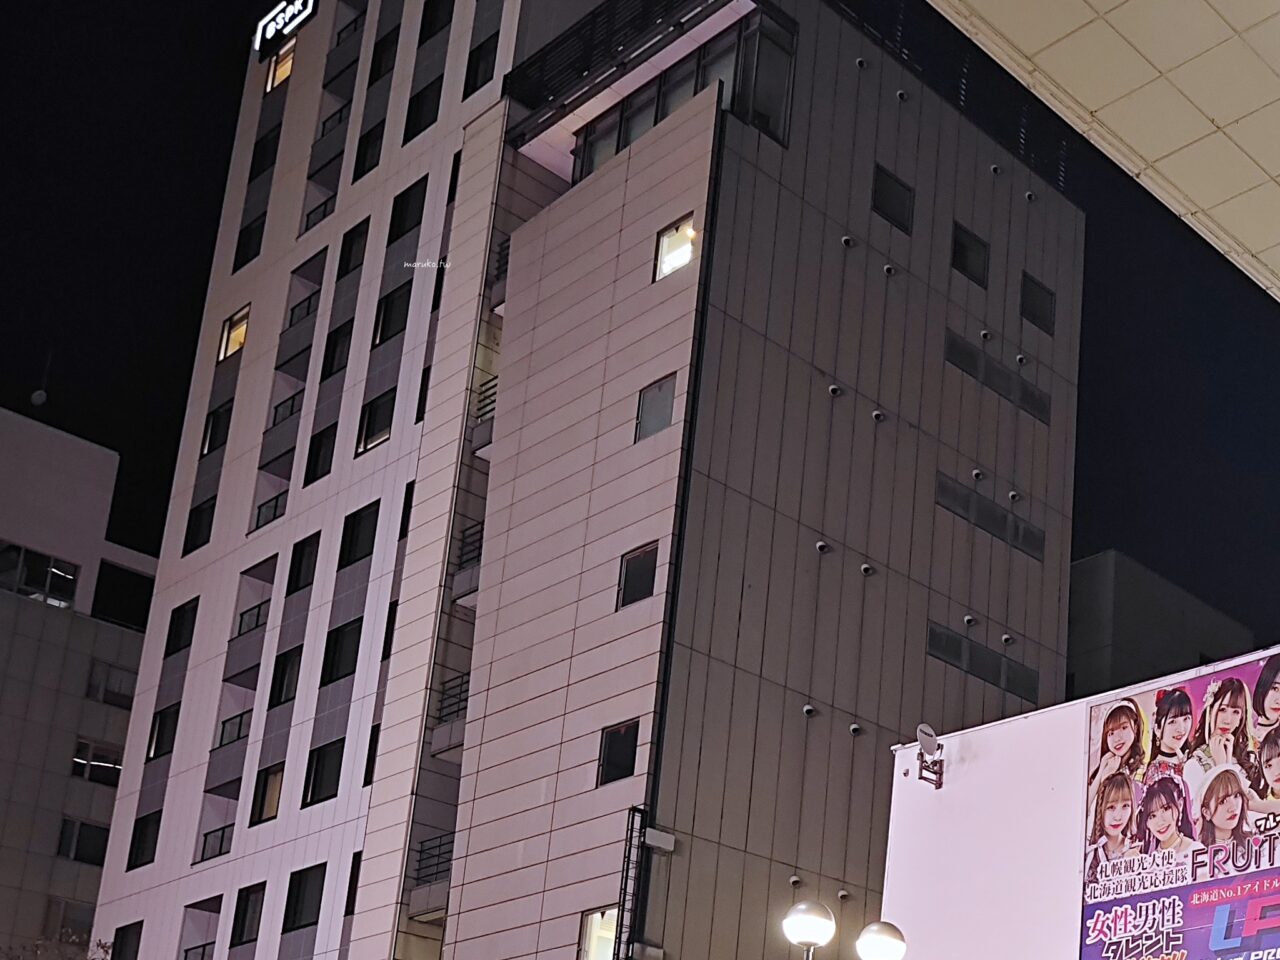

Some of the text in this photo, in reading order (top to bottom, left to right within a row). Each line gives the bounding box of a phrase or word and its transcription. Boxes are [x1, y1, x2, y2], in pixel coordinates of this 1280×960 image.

[1098, 850, 1174, 882] 札幌観光大使
[1086, 868, 1189, 901] 北海道観光応援隊
[1085, 896, 1184, 944] 女性男性
